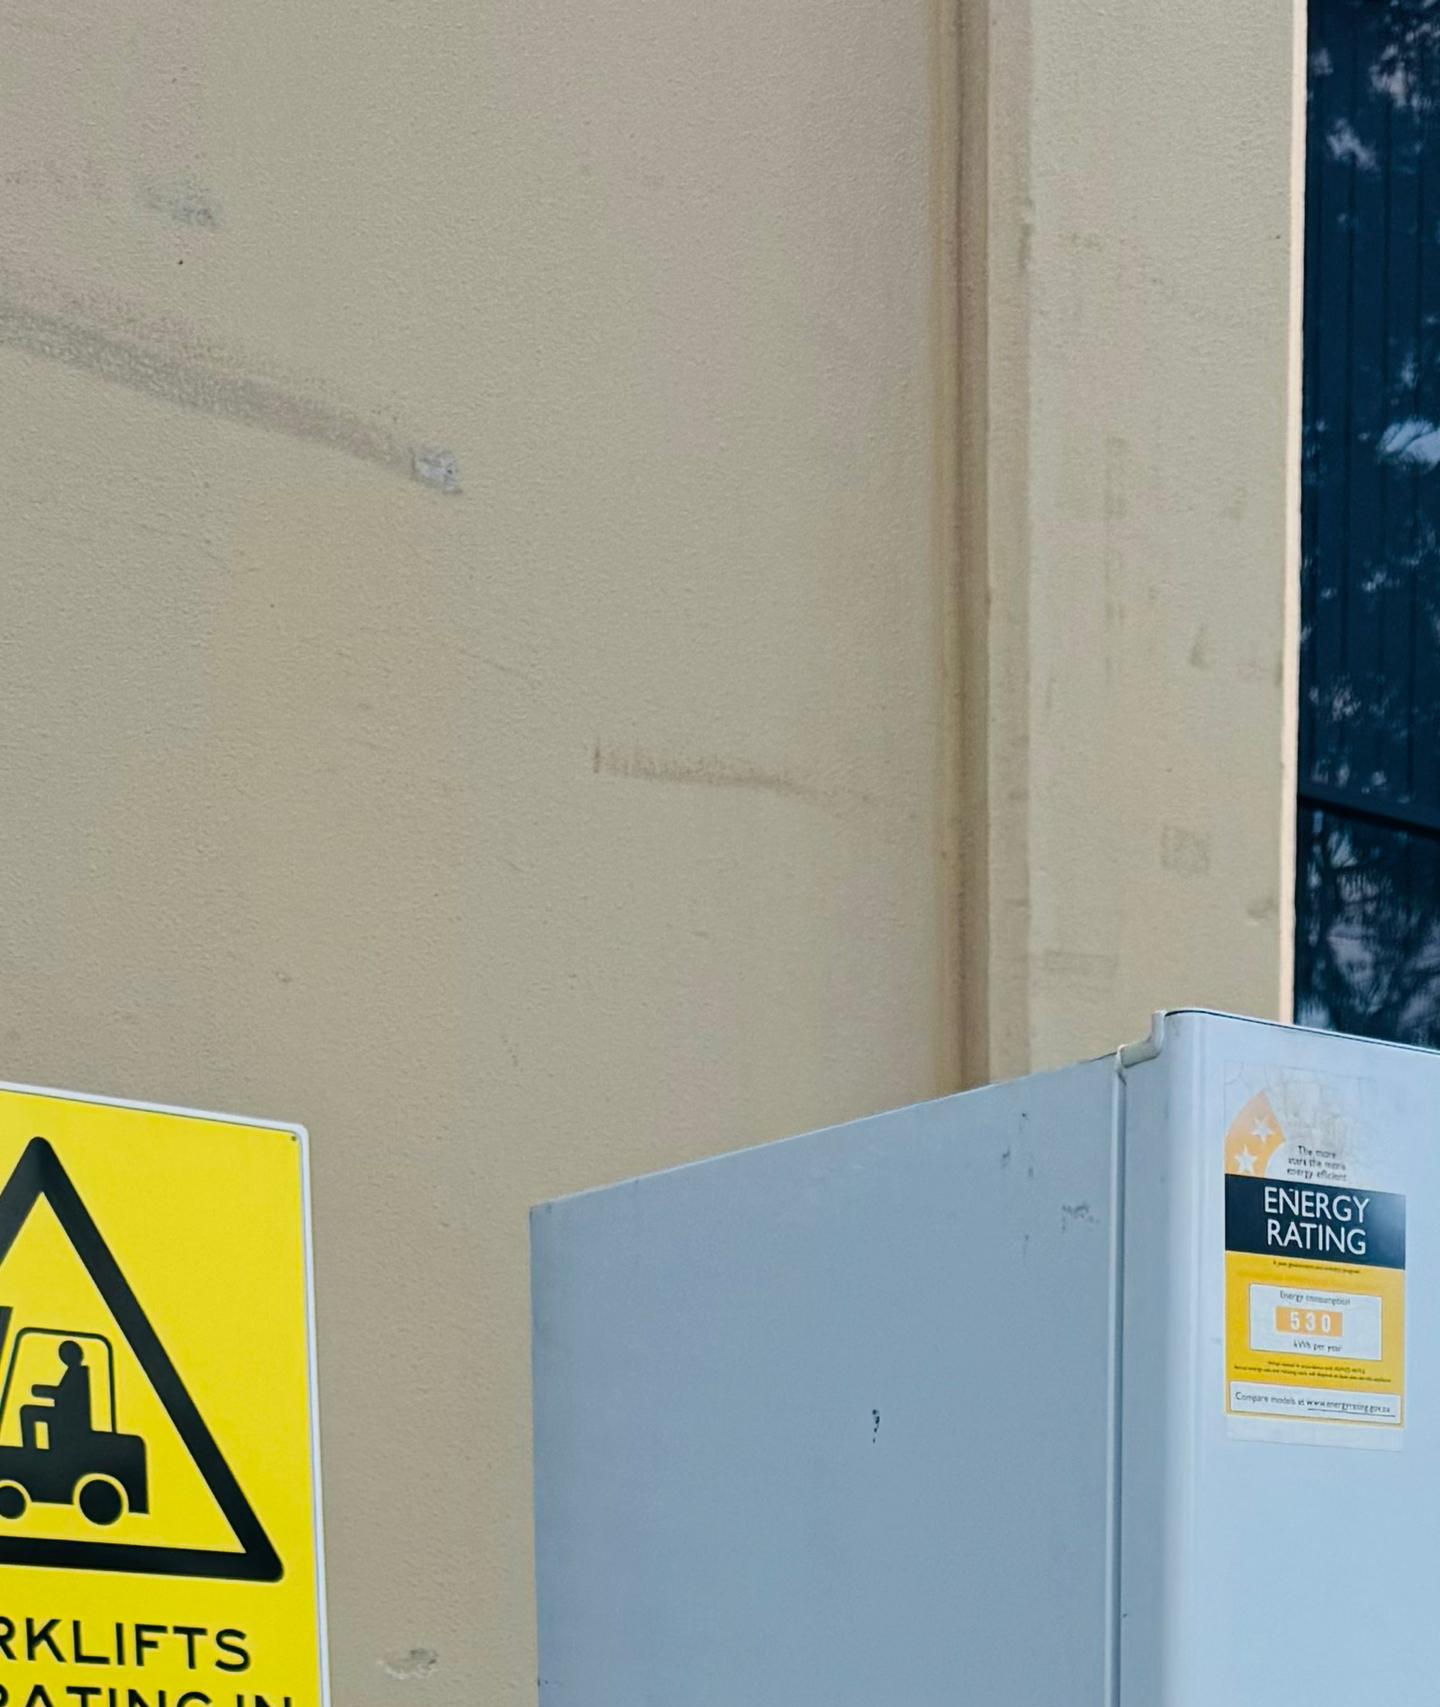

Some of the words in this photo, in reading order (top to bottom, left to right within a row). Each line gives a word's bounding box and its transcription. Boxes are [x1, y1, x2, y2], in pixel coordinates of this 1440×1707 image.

[1298, 1145, 1313, 1156] The
[1287, 1168, 1313, 1180] energy
[1264, 1186, 1370, 1223] ENERGY
[1267, 1218, 1367, 1255] RATING
[1280, 1290, 1304, 1303] Energy
[1306, 1295, 1351, 1306] consumption
[1235, 1391, 1269, 1404] Compare
[1271, 1396, 1296, 1406] models
